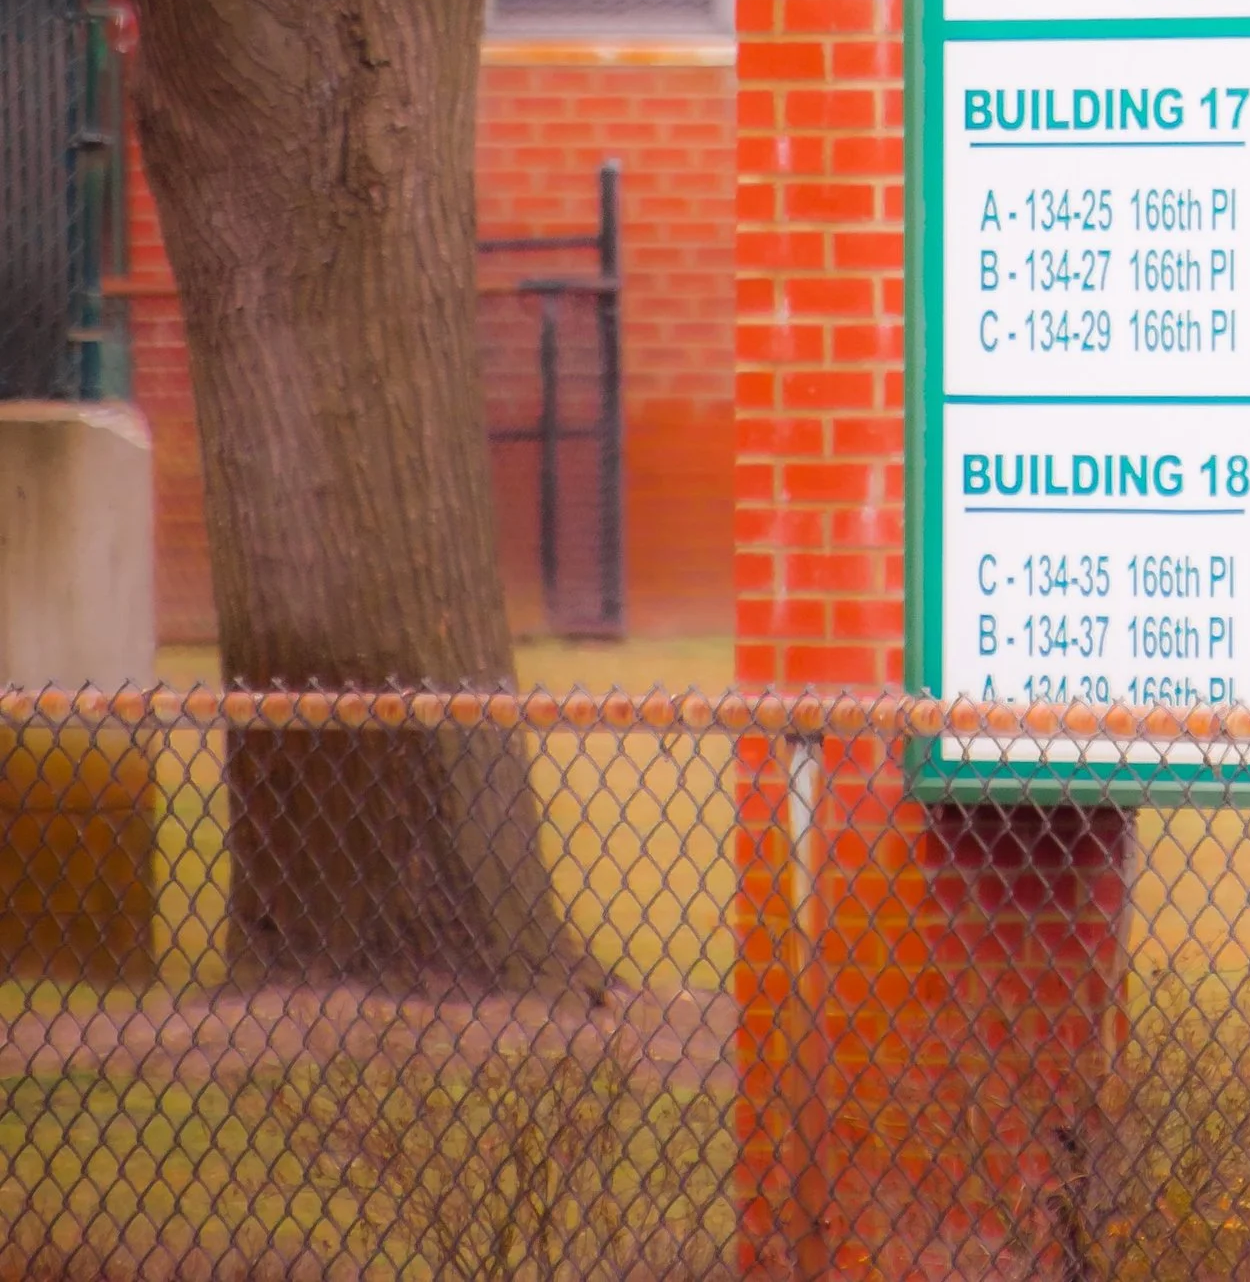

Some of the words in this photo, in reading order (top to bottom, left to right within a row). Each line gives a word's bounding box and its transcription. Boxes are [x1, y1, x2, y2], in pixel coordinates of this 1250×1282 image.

[963, 86, 1185, 132] BUILDING
[1200, 86, 1250, 130] 17
[980, 189, 1002, 232] A
[1025, 189, 1113, 232] 134-25
[1130, 189, 1202, 232] 166th
[1212, 189, 1236, 232] Pl
[980, 249, 1000, 292] B
[1025, 249, 1112, 292] 134-27
[1129, 249, 1202, 292] 166th
[1211, 249, 1236, 292] Pl
[979, 309, 999, 353] C
[1025, 309, 1112, 353] 134-29
[1129, 309, 1202, 353] 166th
[1211, 309, 1236, 353] Pl
[962, 453, 1185, 498] BUILDING
[1200, 453, 1250, 498] 18
[977, 554, 998, 598] C
[1023, 554, 1110, 598] 134-35
[1127, 554, 1200, 598] 166th
[1209, 554, 1234, 598] Pl
[978, 614, 998, 658] B
[1023, 614, 1110, 658] 134-37
[1127, 614, 1200, 658] 166th
[1208, 614, 1233, 658] Pl
[1023, 674, 1110, 704] 13439
